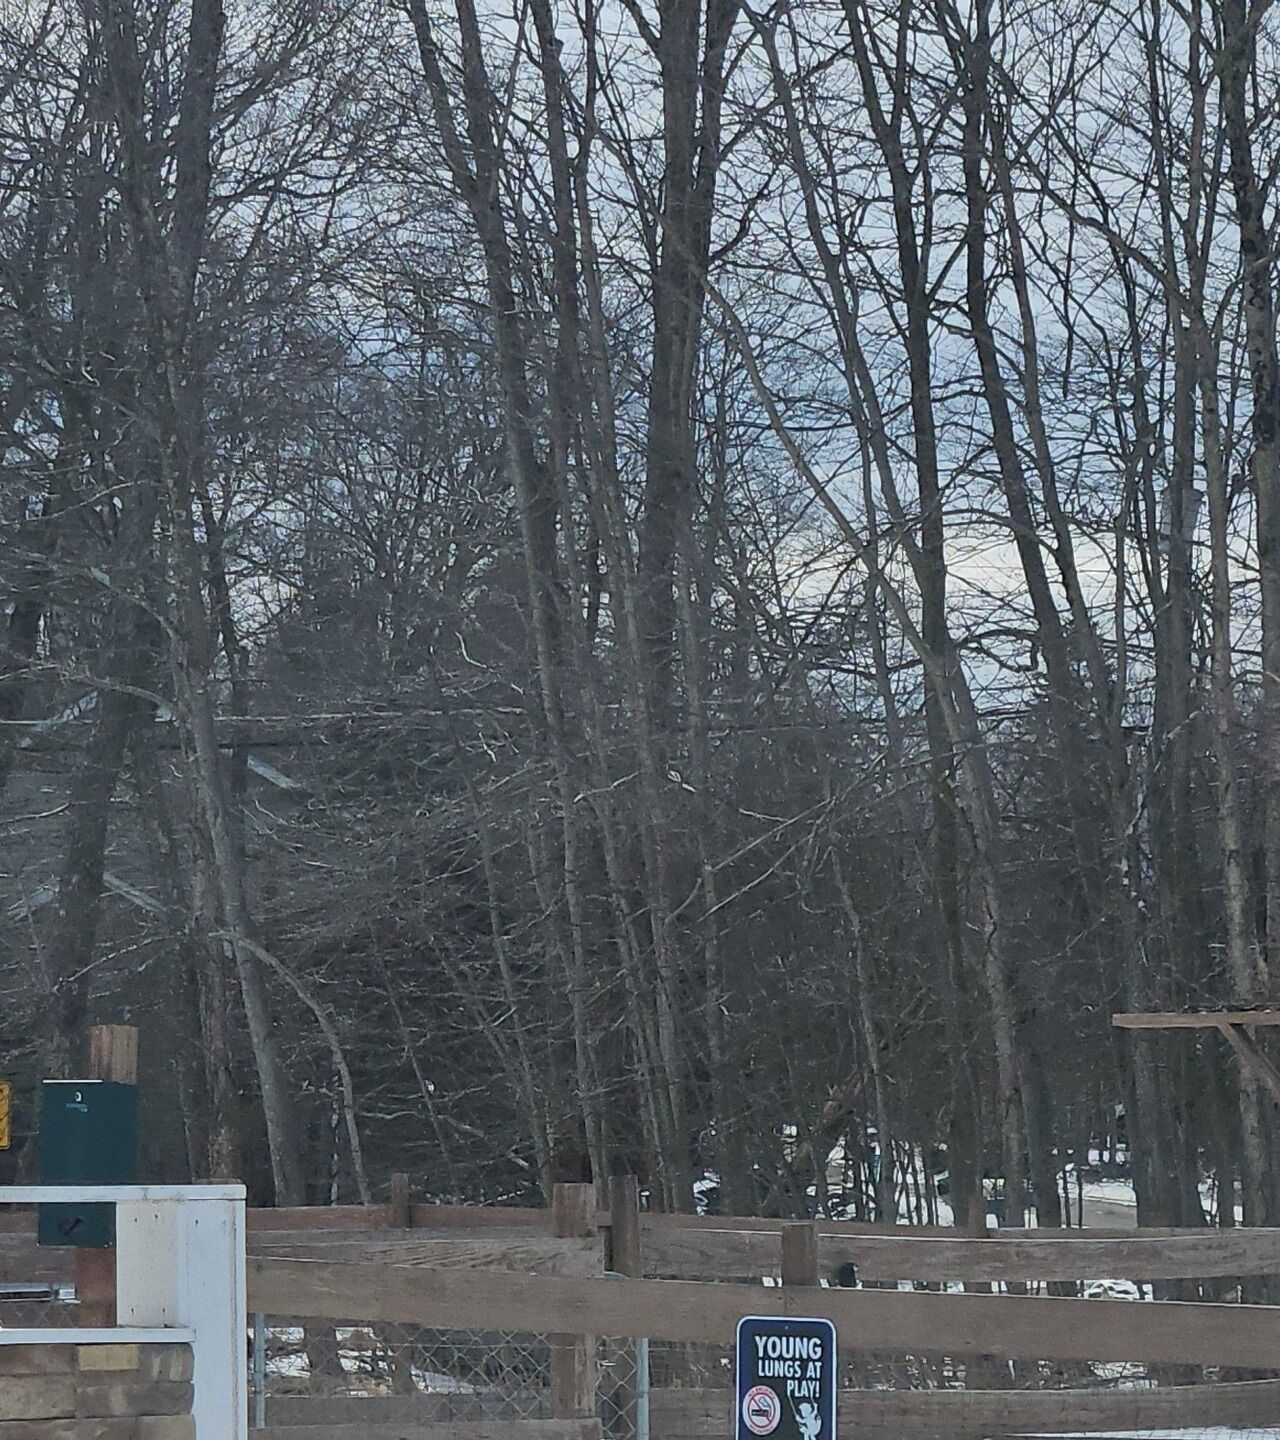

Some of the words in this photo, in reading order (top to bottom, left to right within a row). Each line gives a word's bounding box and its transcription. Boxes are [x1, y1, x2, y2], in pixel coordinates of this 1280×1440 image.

[754, 1335, 822, 1359] YOUNG
[758, 1359, 802, 1378] LUNGS
[806, 1361, 822, 1379] AT
[787, 1379, 820, 1398] PLAY!
